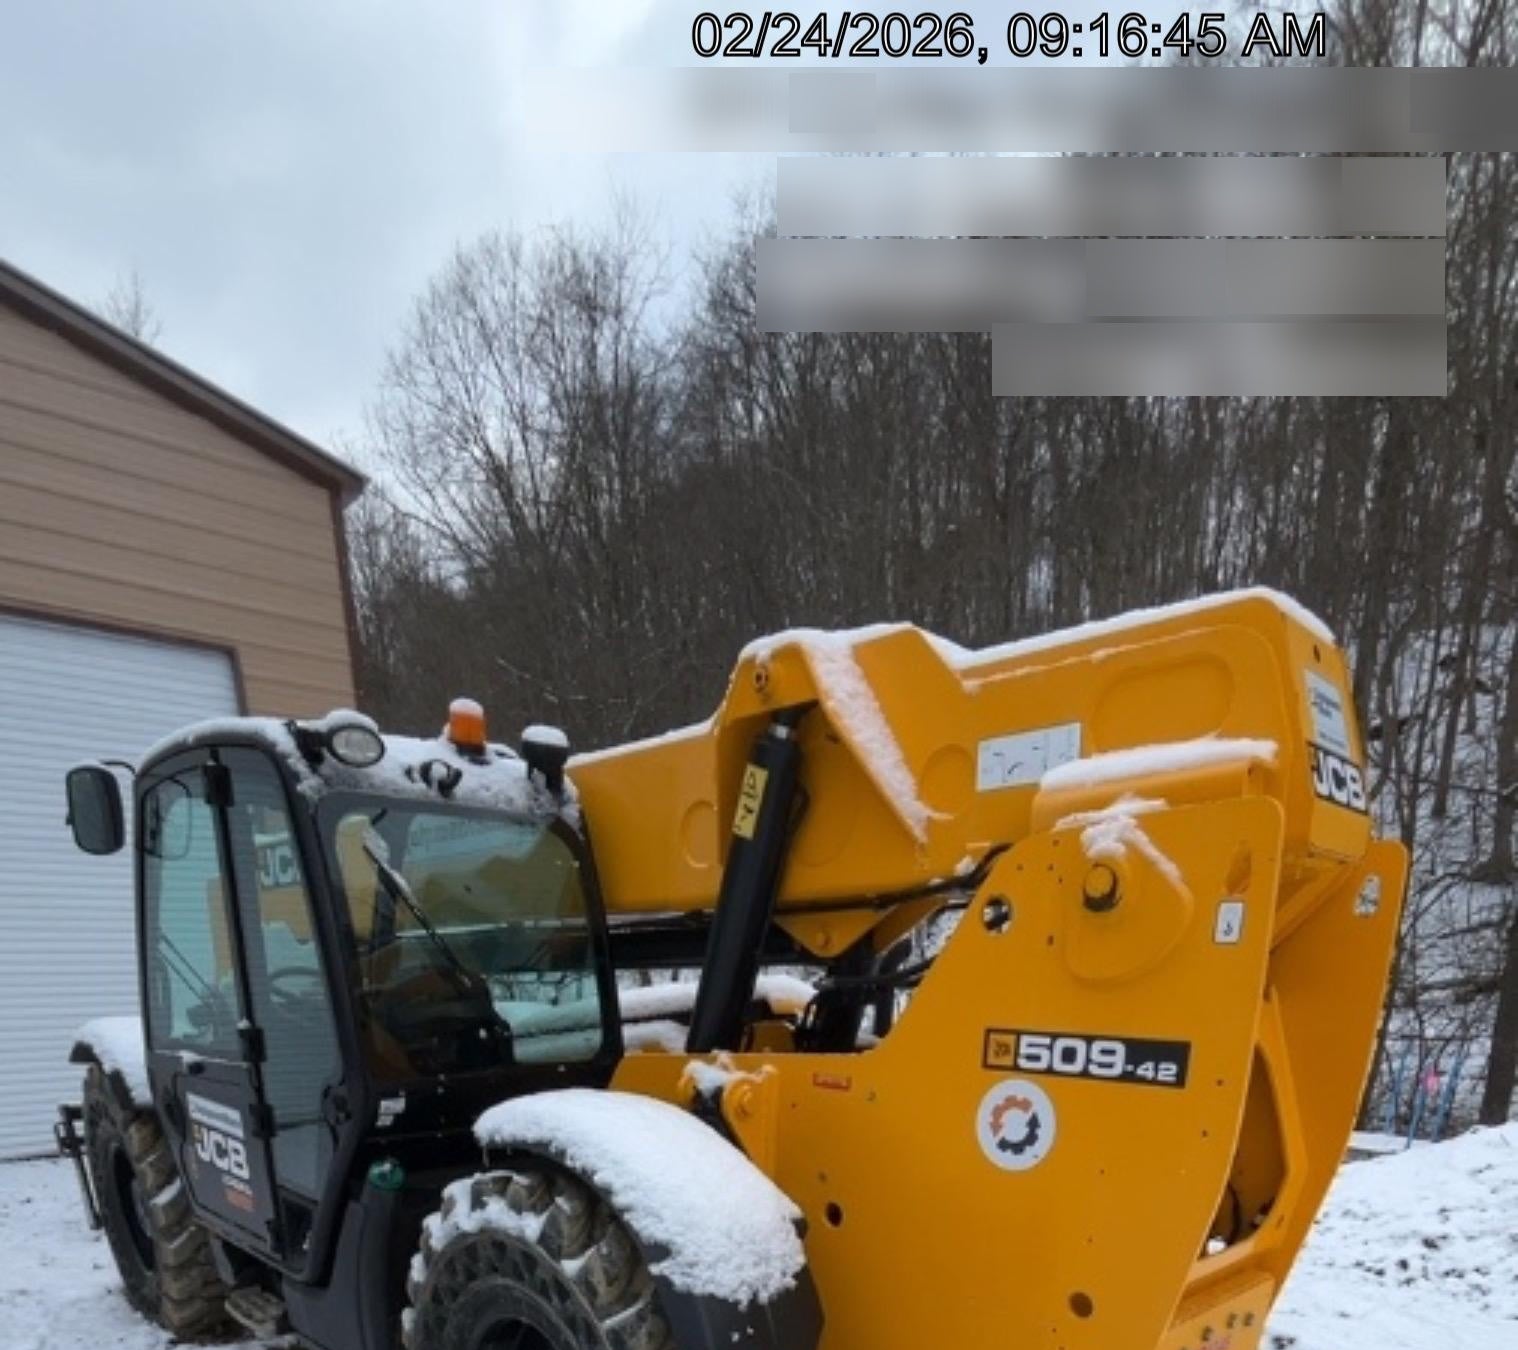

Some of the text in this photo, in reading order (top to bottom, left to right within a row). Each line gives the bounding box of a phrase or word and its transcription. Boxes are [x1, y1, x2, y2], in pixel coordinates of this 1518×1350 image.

[1312, 750, 1368, 812] JCB
[260, 846, 301, 886] JC
[195, 1126, 250, 1180] JCB
